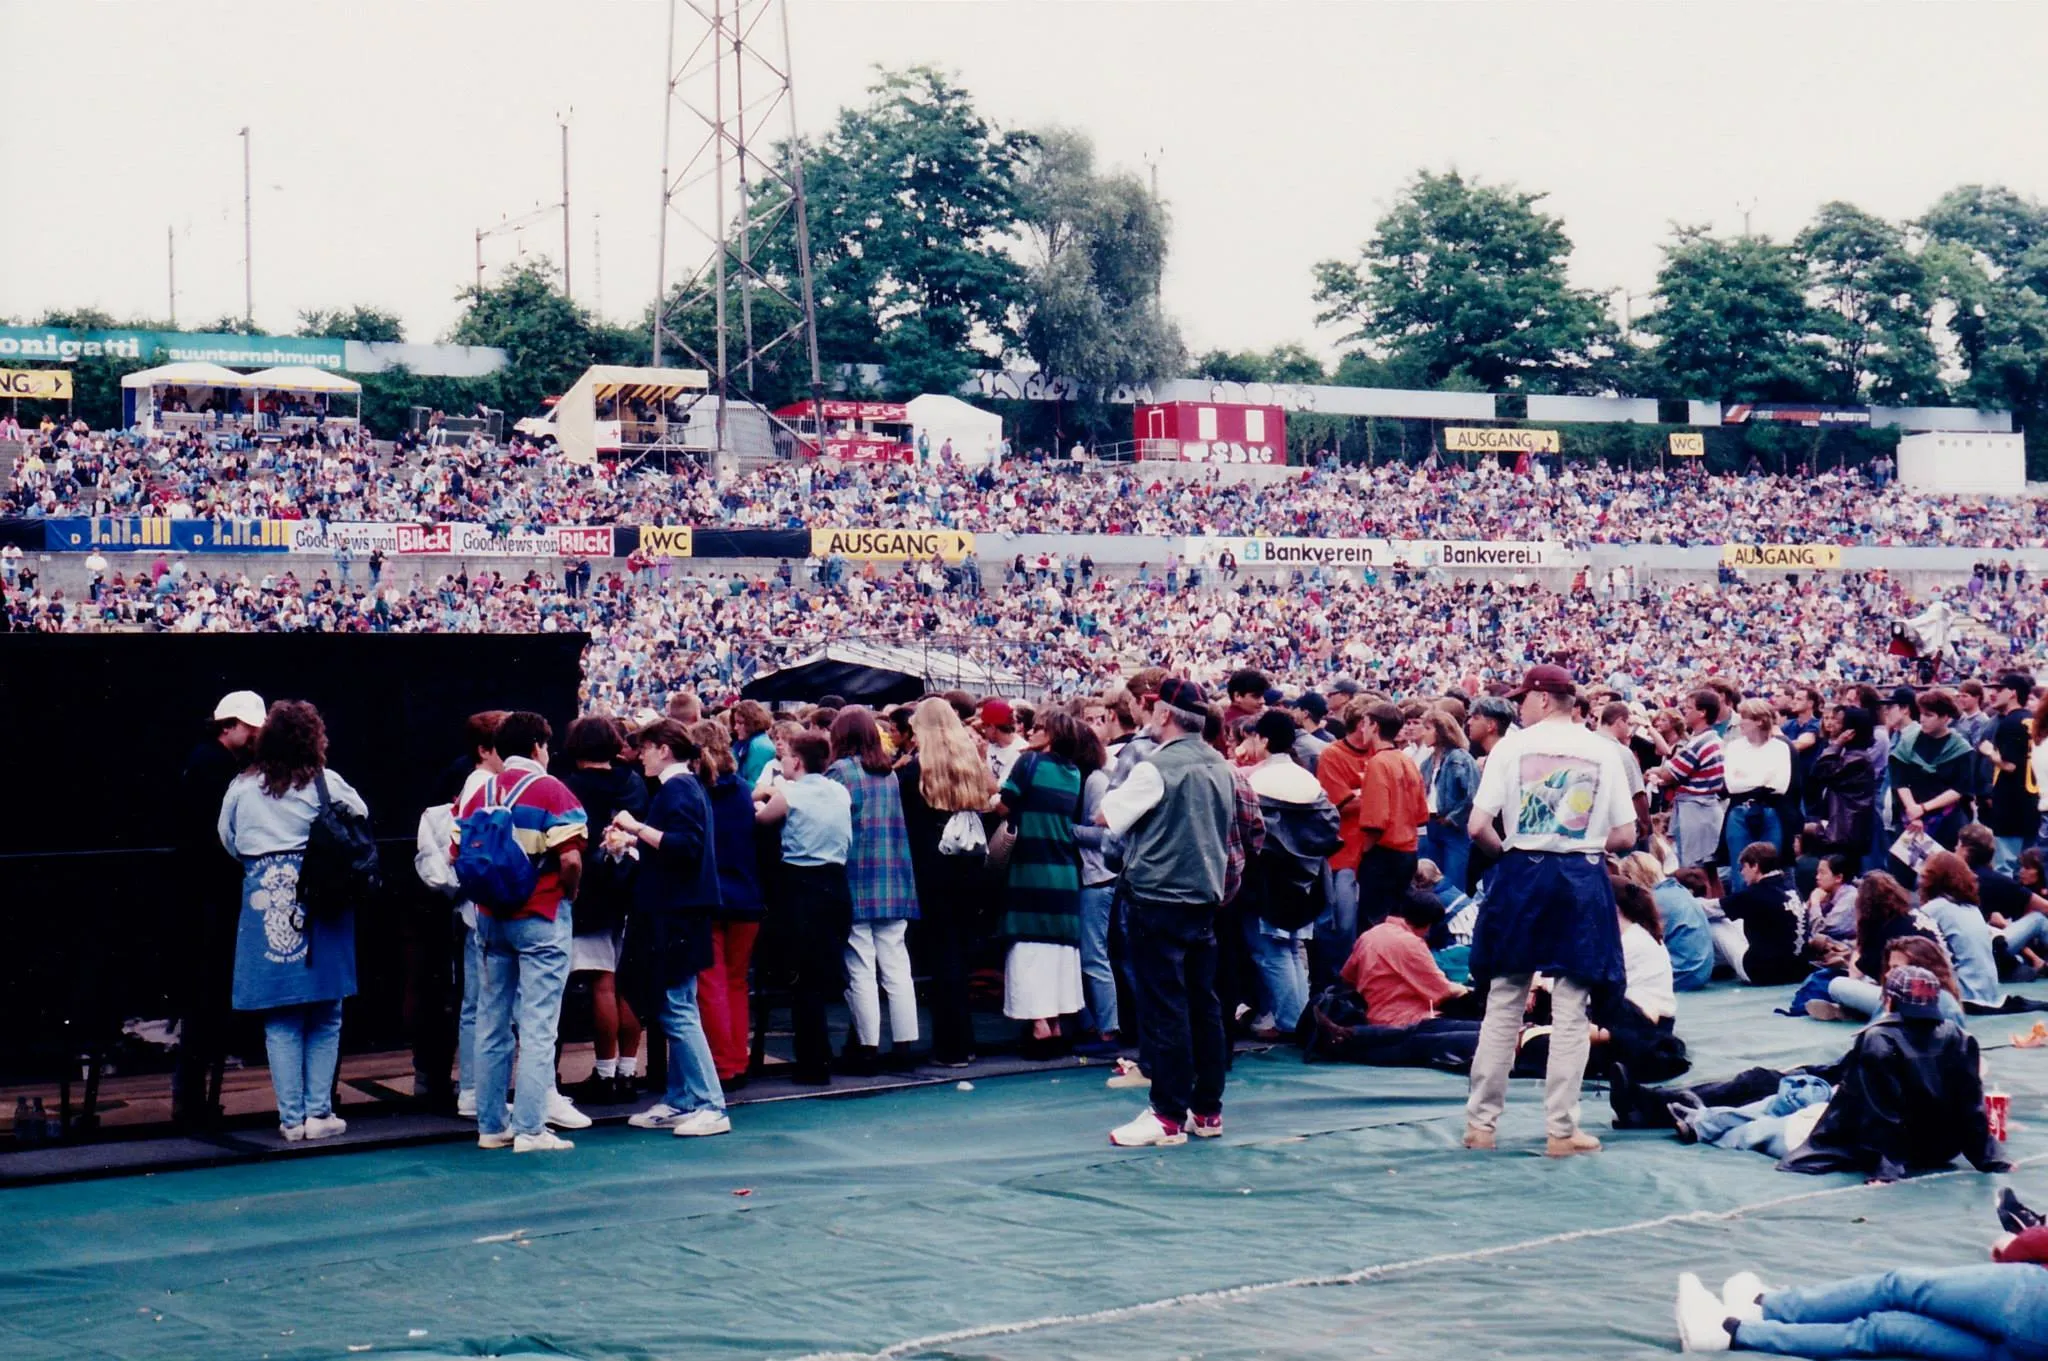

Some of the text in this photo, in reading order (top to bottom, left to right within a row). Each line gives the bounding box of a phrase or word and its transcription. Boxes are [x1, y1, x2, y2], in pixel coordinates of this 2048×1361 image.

[154, 345, 341, 369] auunternehmung
[1457, 432, 1533, 448] AUSGANG
[1672, 438, 1696, 451] WC
[372, 537, 396, 550] von
[398, 527, 450, 551] Blick
[536, 539, 558, 552] von
[560, 530, 609, 552] Blick
[652, 531, 688, 549] WC
[829, 533, 938, 554] AUSGANG
[1265, 542, 1372, 561] Bankverein
